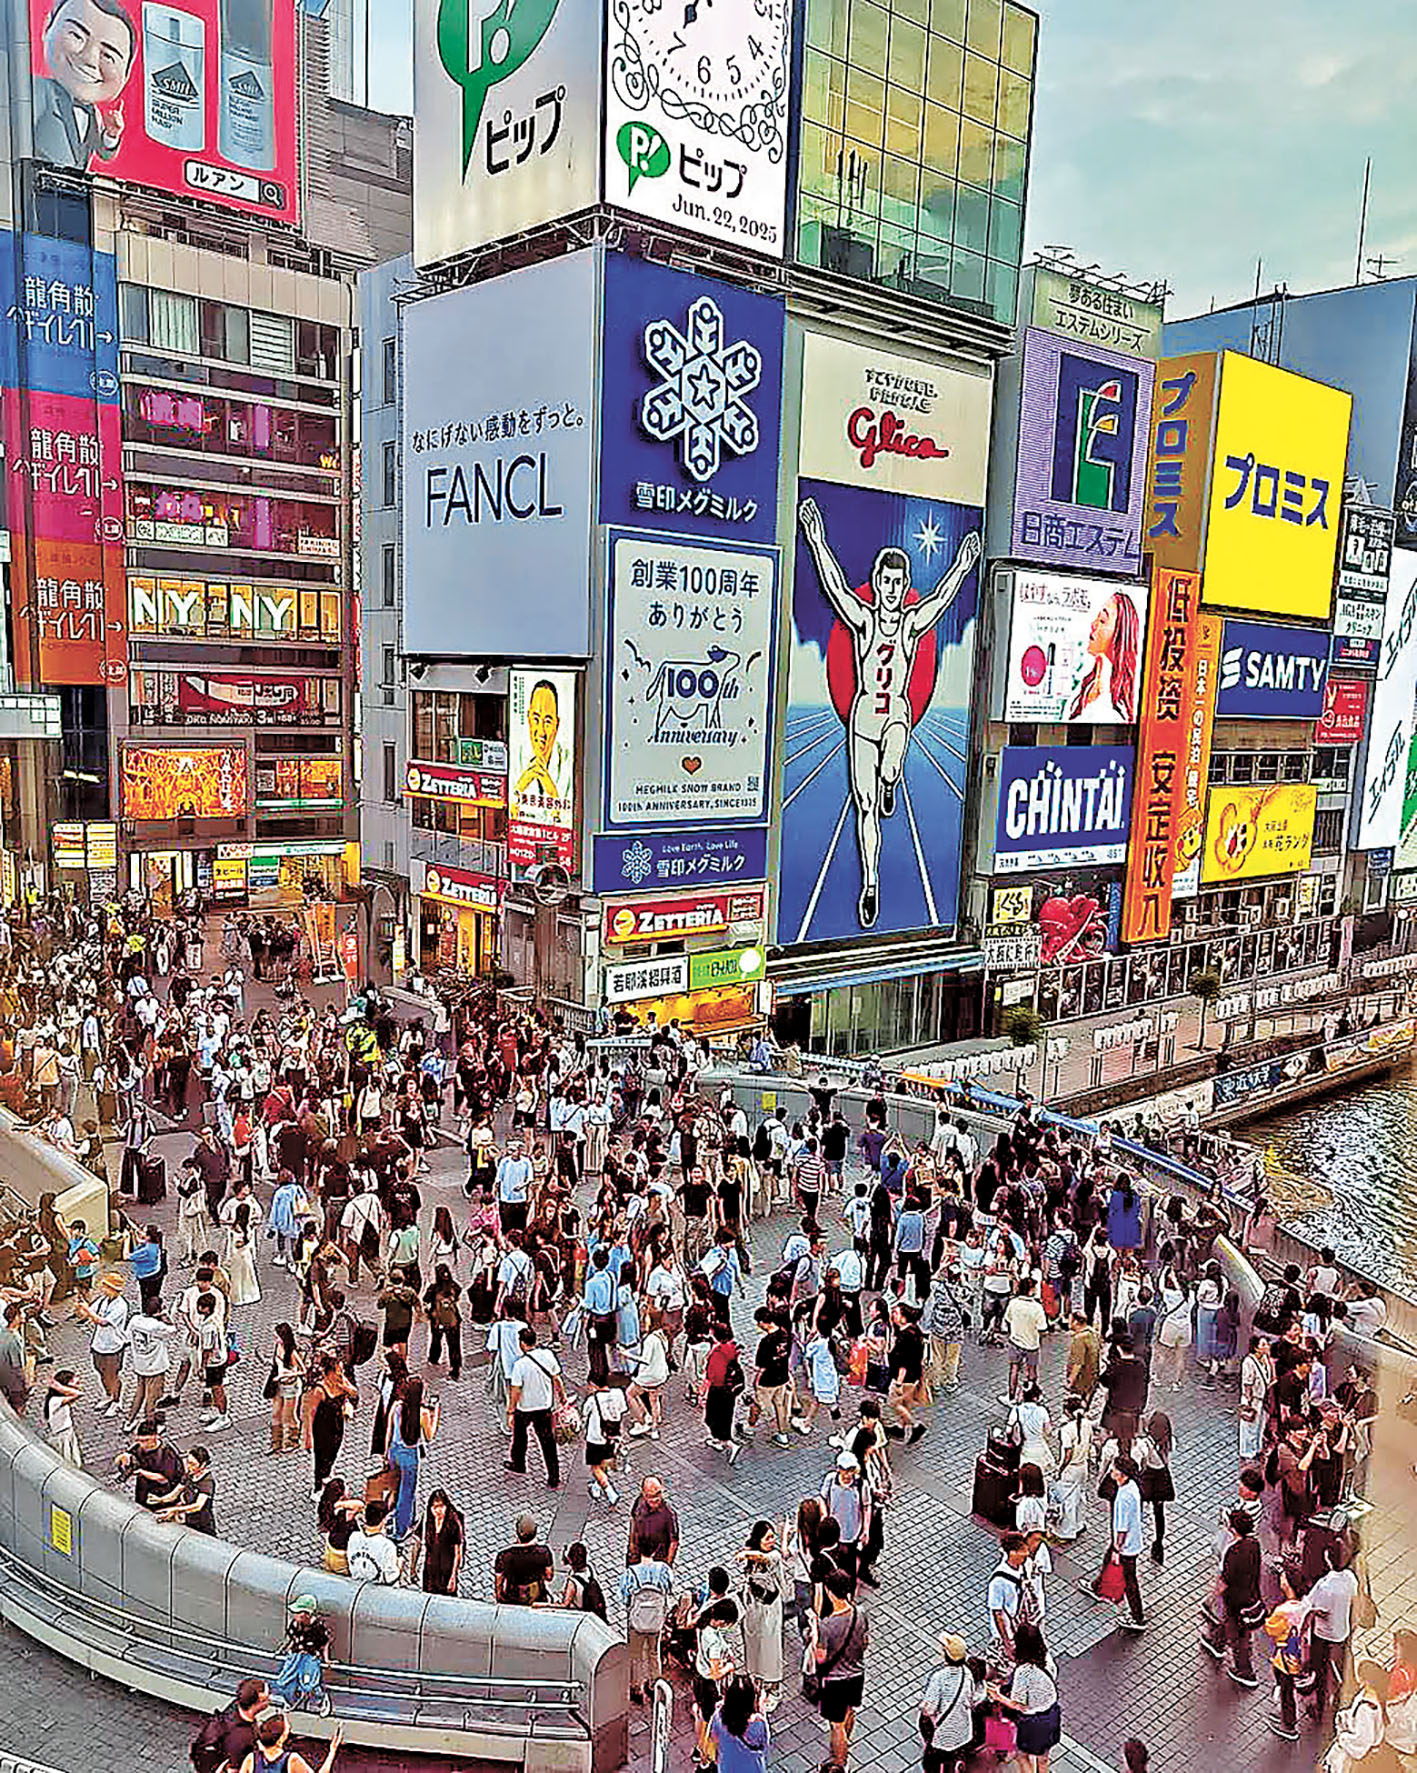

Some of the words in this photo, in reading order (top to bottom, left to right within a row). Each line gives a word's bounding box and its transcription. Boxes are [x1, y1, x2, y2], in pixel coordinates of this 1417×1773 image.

[485, 84, 566, 176] ピップ
[193, 167, 245, 191] ルアン
[679, 142, 748, 199] ピップ
[1055, 309, 1143, 352] エステムシリーズ
[847, 406, 950, 469] Glico
[1148, 371, 1197, 537] プロミス
[425, 452, 562, 528] FANCL
[635, 481, 758, 524] 雪印メグミルク
[1224, 452, 1330, 531] プロミス
[1021, 510, 1141, 559] 日商エステム
[631, 558, 760, 599] 創業100周年
[648, 600, 742, 634] ありがとう
[875, 639, 897, 715] グリコ
[1245, 651, 1327, 692] SAMTY
[656, 854, 746, 878] 雪印メグミルク
[637, 909, 724, 933] ZETTERIA
